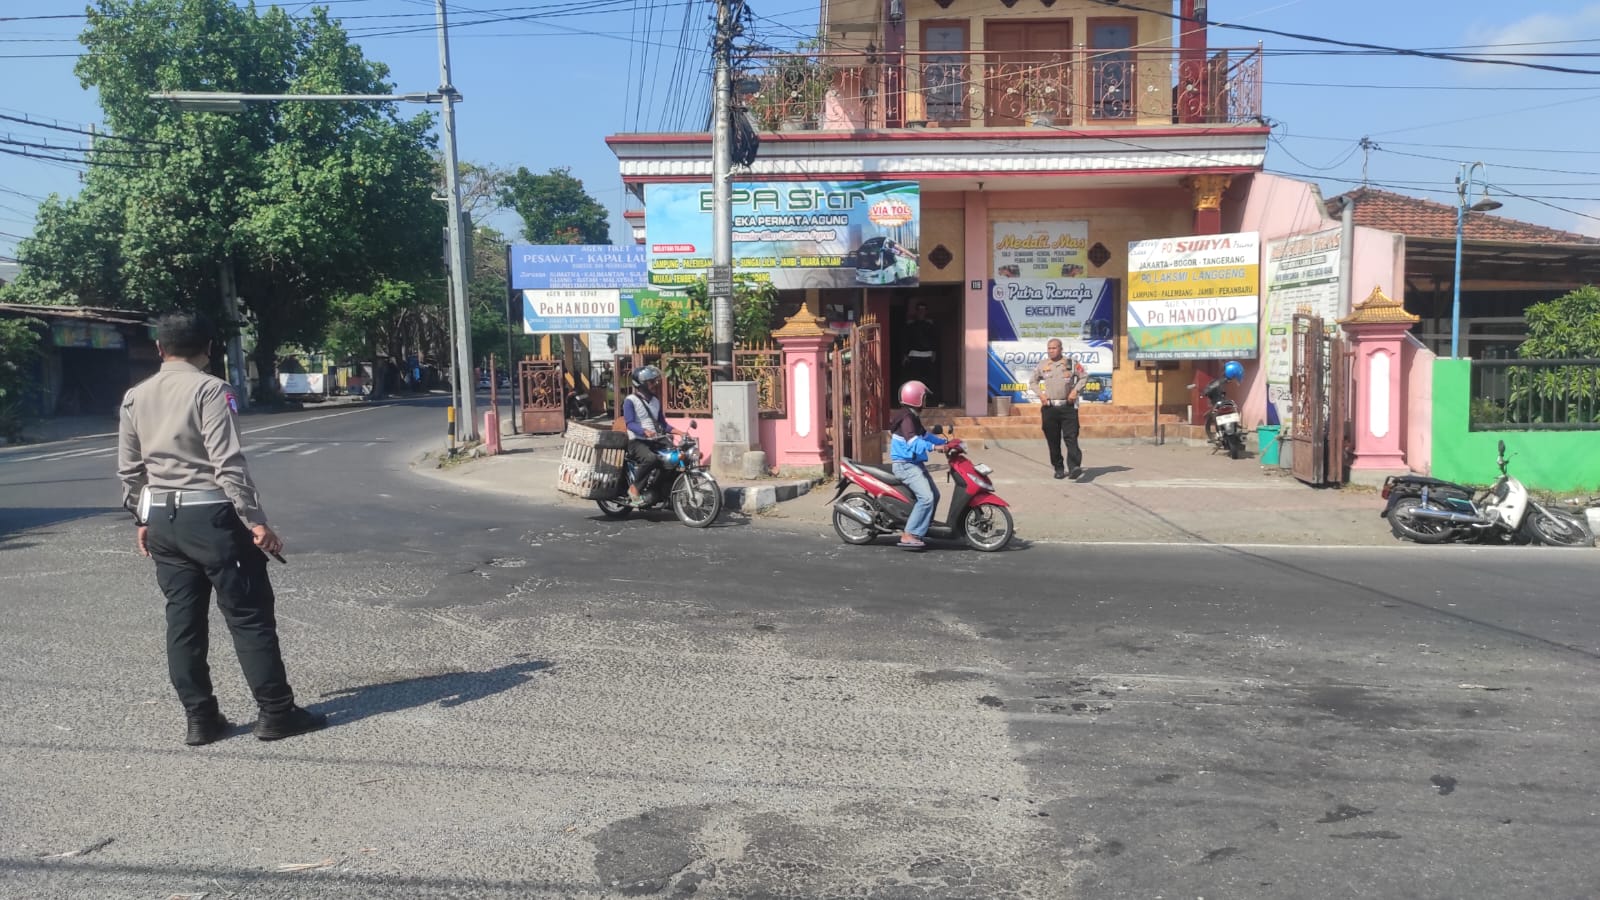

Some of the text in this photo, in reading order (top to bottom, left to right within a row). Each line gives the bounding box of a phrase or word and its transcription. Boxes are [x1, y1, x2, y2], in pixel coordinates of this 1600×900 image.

[787, 188, 866, 210] Star
[873, 206, 909, 215] VIA TOL
[735, 214, 849, 226] EKA PERMATA AGUNG
[1175, 238, 1232, 253] SURYA
[523, 254, 647, 264] PESAWAT KAPAL LAU
[1139, 256, 1245, 270] JAKARTA BOGOR TANGERANG
[1154, 270, 1189, 283] LAKSMI
[1192, 268, 1246, 281] LANGGENG
[1008, 282, 1043, 300] Putra
[1046, 281, 1093, 303] Remaja
[1025, 305, 1076, 316] EXECUTIVE
[1004, 352, 1100, 364] PO MAKOTA
[1000, 383, 1028, 392] JAKARTA
